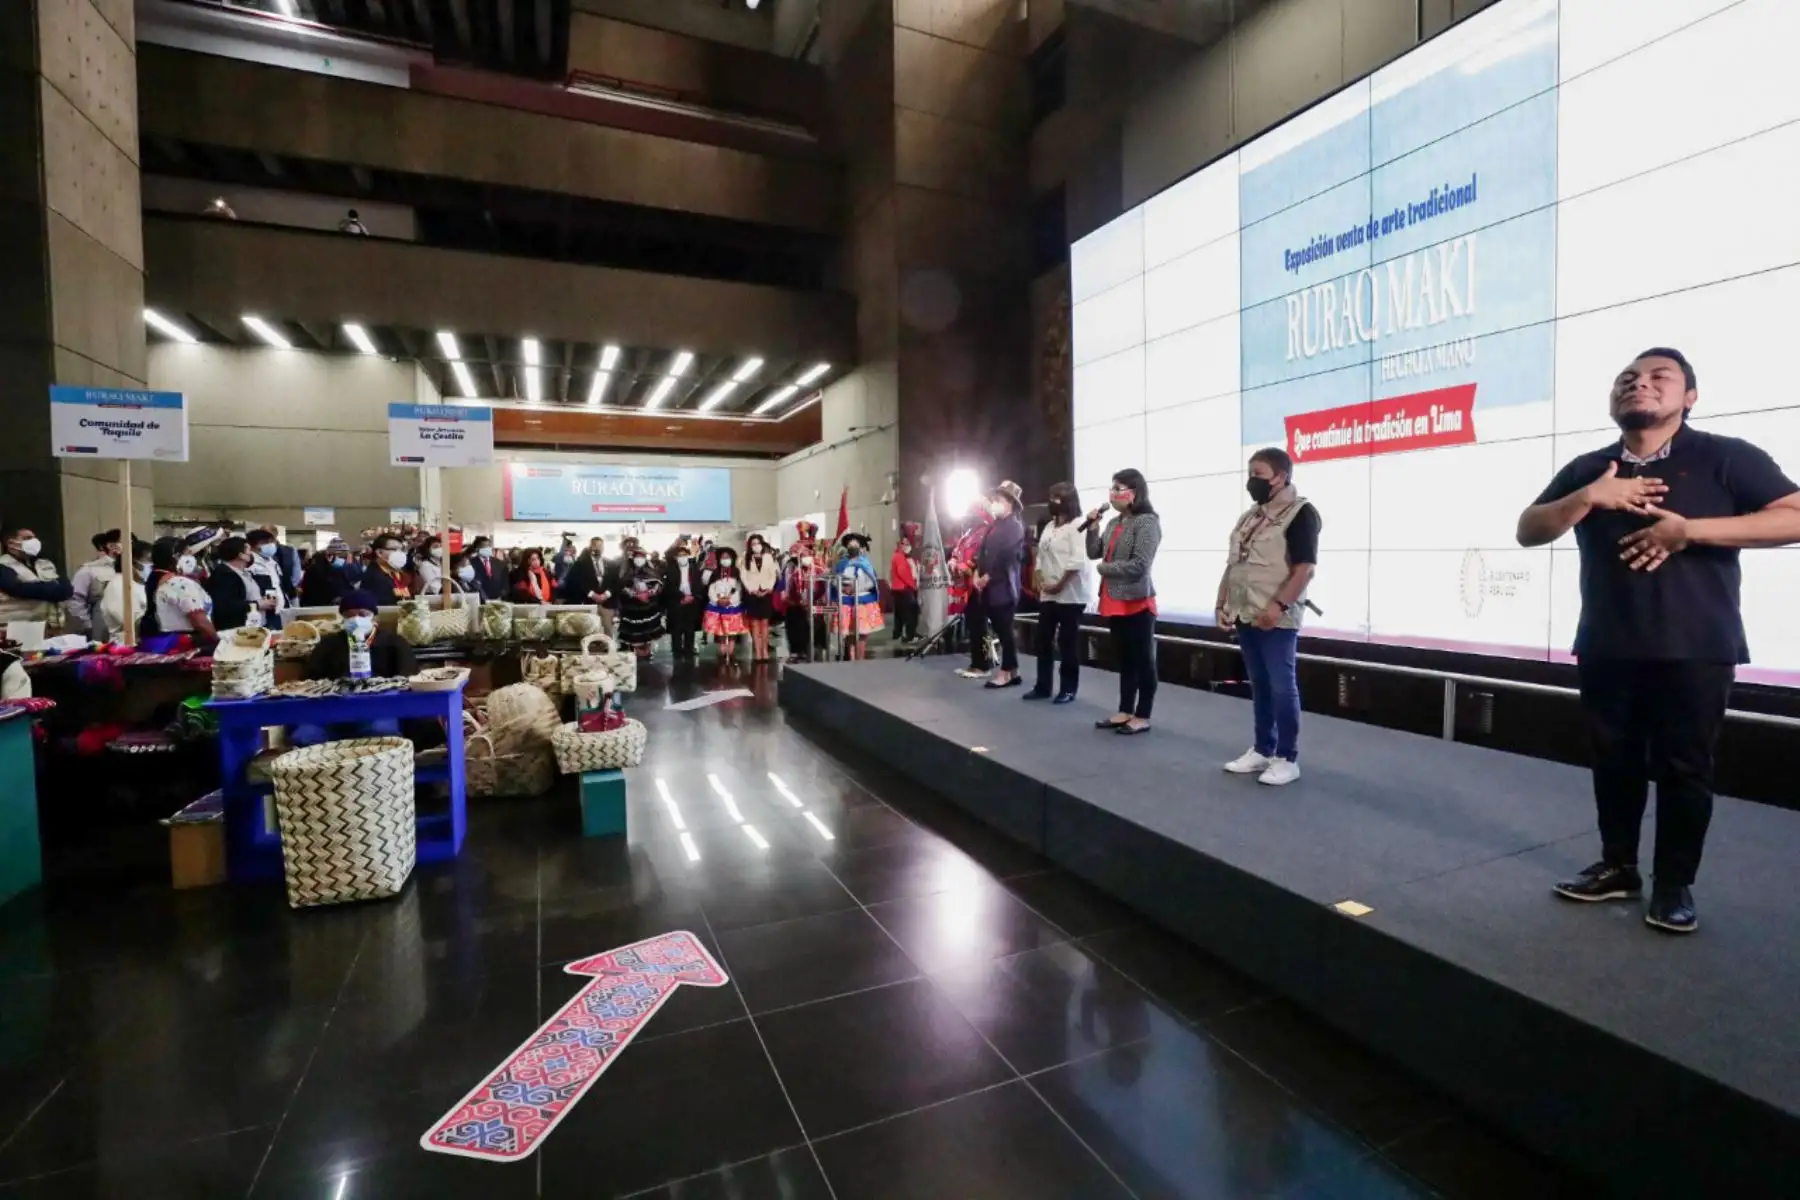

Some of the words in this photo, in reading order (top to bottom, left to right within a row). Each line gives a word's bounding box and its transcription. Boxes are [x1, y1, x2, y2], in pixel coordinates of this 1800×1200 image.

[1284, 233, 1334, 275] Exposición
[1335, 224, 1364, 252] venta
[1366, 212, 1379, 242] de
[1381, 207, 1405, 236] arte
[1407, 172, 1477, 226] tradicional
[1384, 234, 1477, 337] MAKI
[79, 418, 145, 429] Comunidad
[146, 420, 160, 430] de
[1293, 427, 1311, 459] Que
[1353, 419, 1363, 445] la
[1364, 407, 1413, 443] tradición
[1414, 415, 1429, 436] en
[1430, 404, 1462, 434] Lima
[638, 479, 685, 498] MAKI
